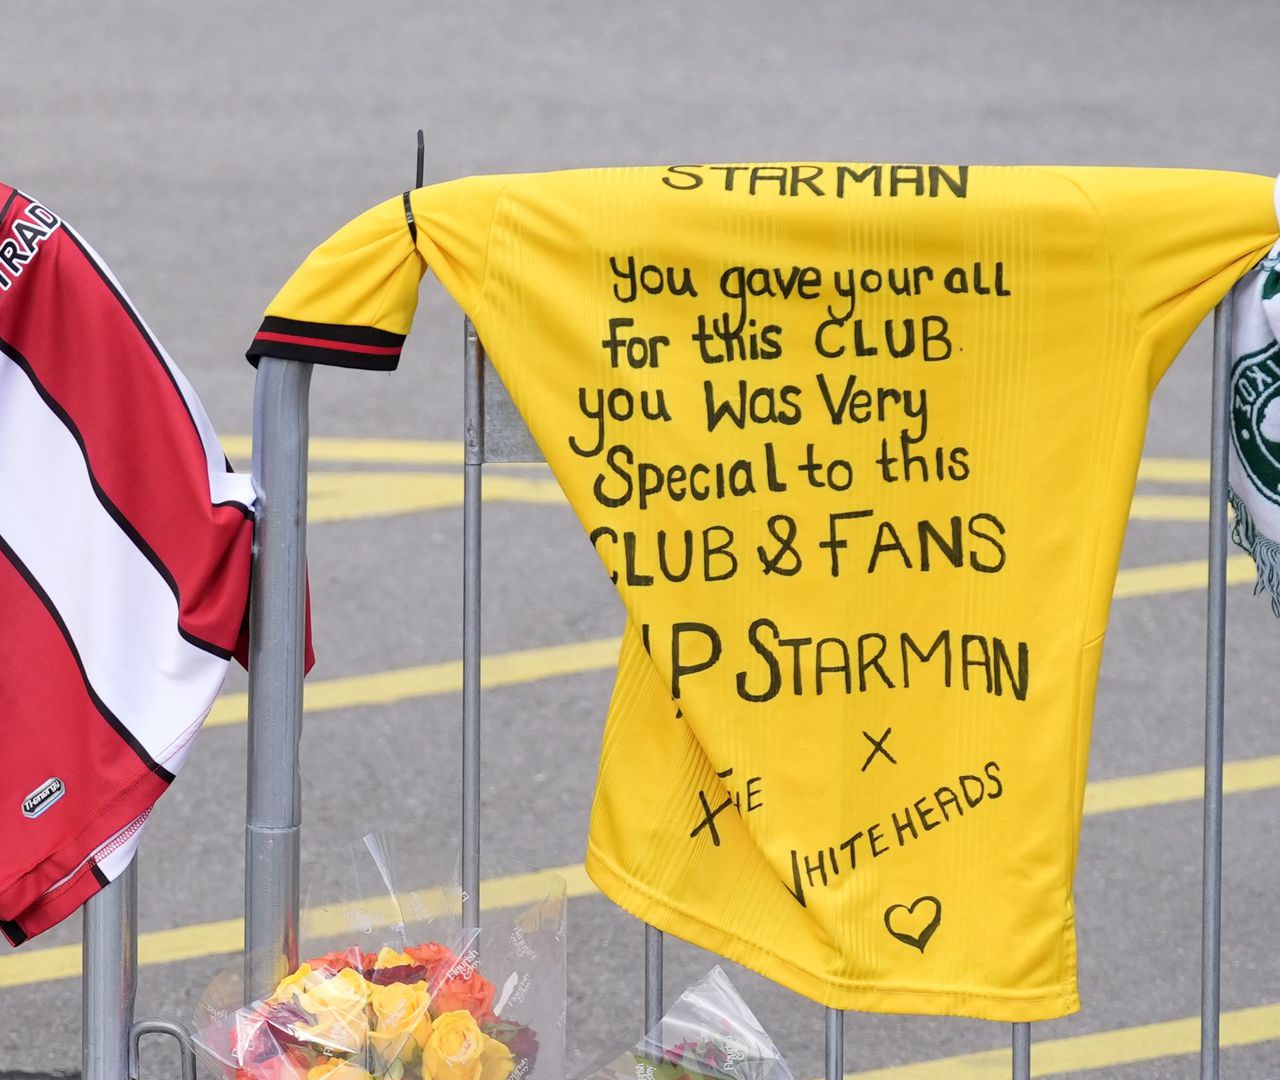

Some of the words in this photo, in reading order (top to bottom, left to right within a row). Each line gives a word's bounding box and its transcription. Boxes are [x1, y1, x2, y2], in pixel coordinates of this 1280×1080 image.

[661, 163, 969, 199] STARMAN
[720, 262, 822, 334] gave
[827, 265, 934, 322] your
[943, 262, 1011, 297] all
[691, 313, 782, 364] this
[815, 315, 952, 363] CLUB
[593, 443, 786, 510] Special
[798, 447, 854, 491] to
[876, 439, 971, 485] this
[757, 513, 801, 577] &
[819, 509, 1006, 577] FANS
